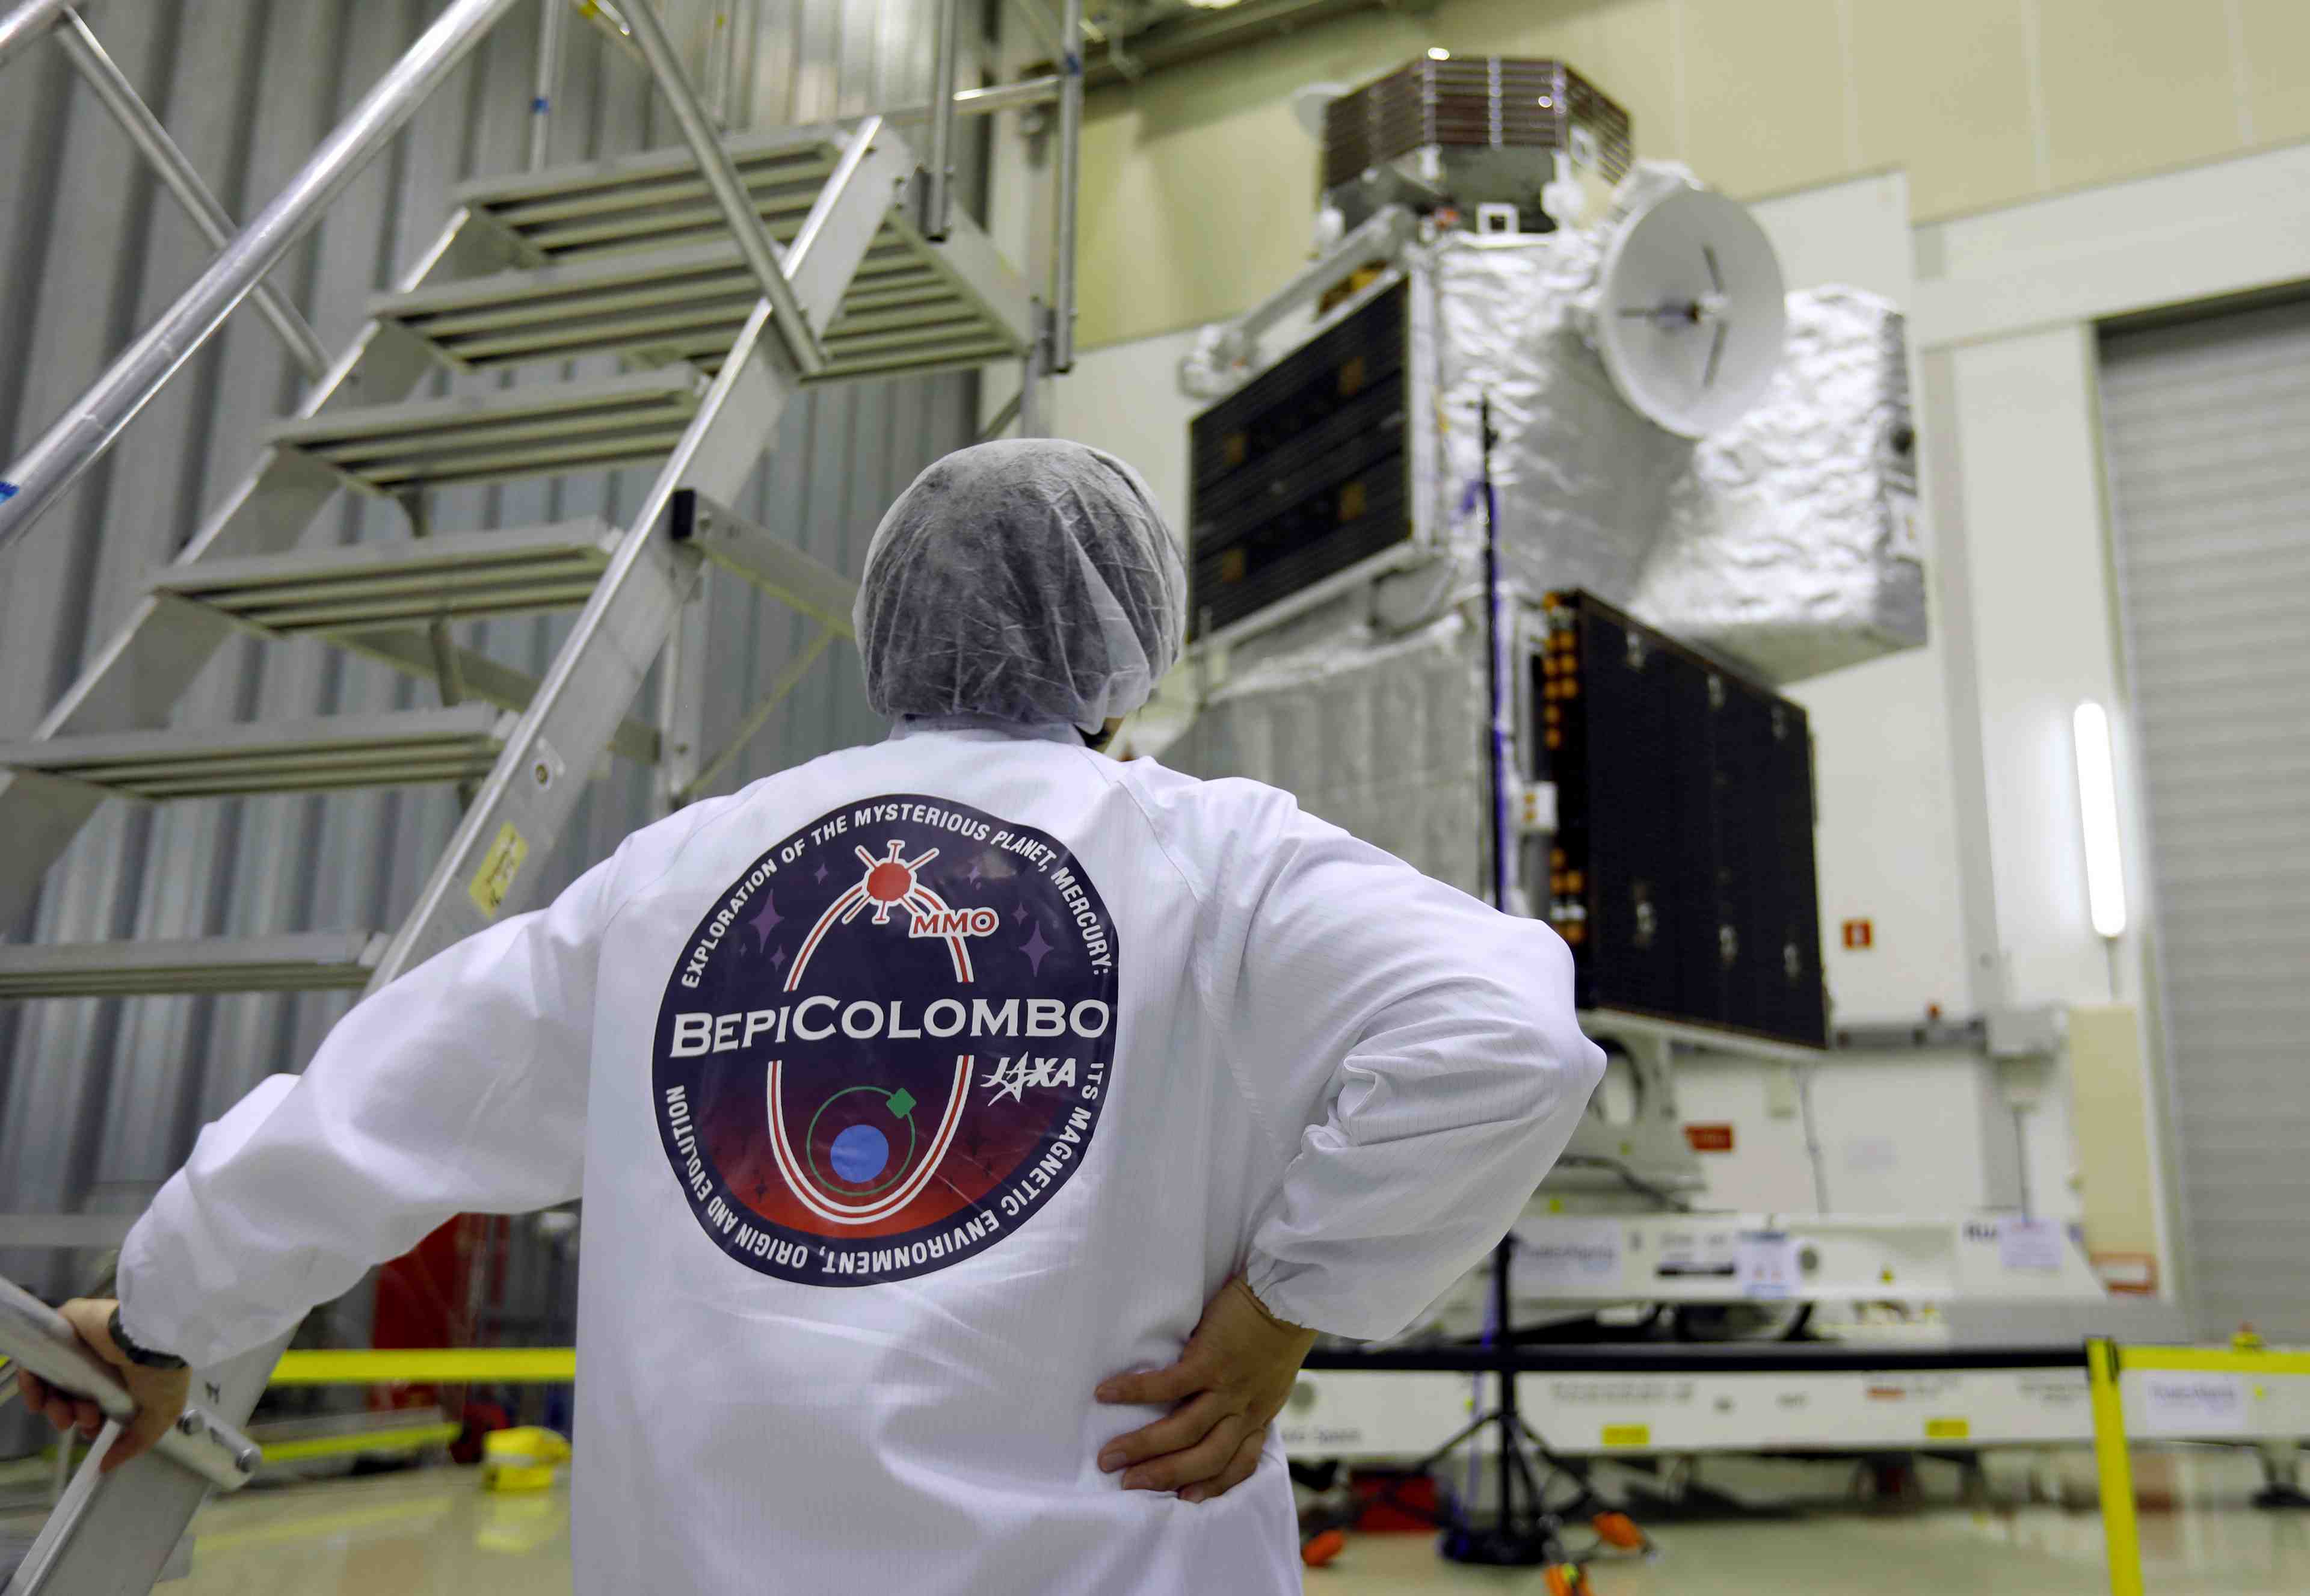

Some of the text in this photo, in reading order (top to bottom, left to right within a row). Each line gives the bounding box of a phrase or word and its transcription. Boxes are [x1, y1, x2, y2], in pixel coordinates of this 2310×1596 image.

[682, 803, 1112, 990] EXPLORATION OF THE MYSTERIOUS PLANET, MERCURY:
[913, 910, 996, 934] MMO
[981, 1050, 1076, 1106] JAXA
[667, 1061, 1104, 1274] ITS MAGNETIC ENVIRONMENT, ORIGIN AND EVOLUTION
